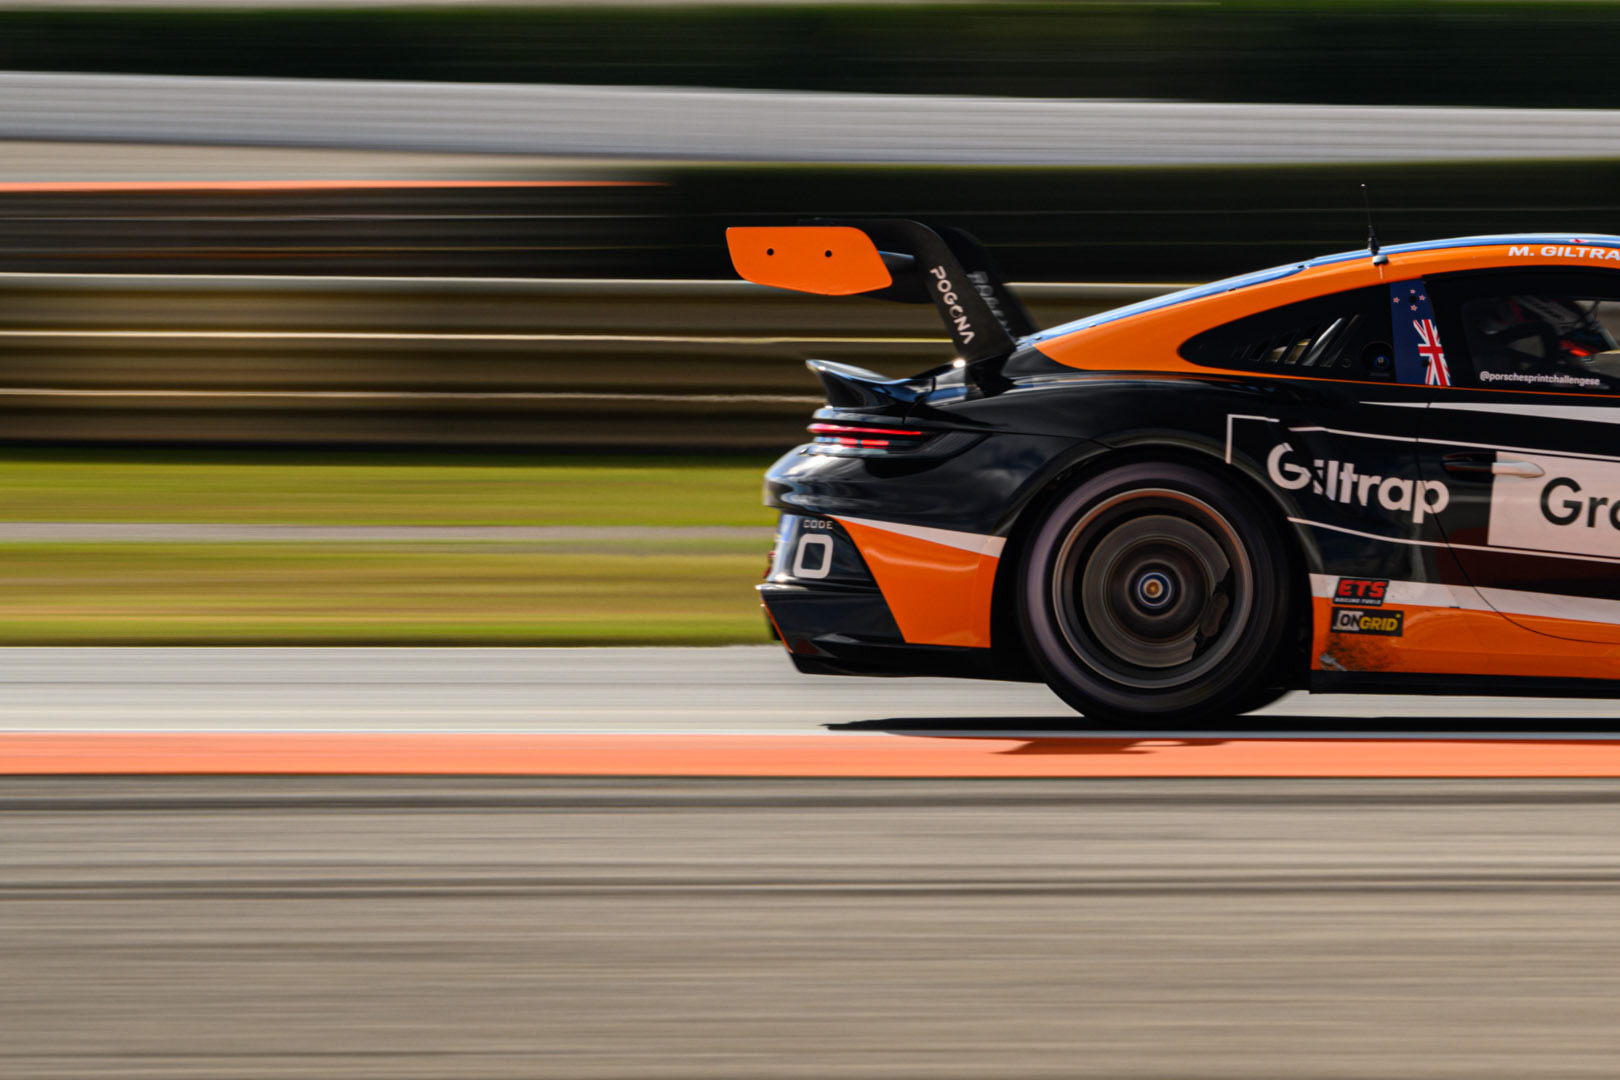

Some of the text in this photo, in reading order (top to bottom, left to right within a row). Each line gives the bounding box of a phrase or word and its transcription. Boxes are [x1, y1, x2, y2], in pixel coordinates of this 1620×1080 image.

[1508, 246, 1535, 257] M.
[1267, 442, 1450, 524] Giltrap
[803, 520, 833, 530] CODE
[1337, 579, 1388, 598] ETS
